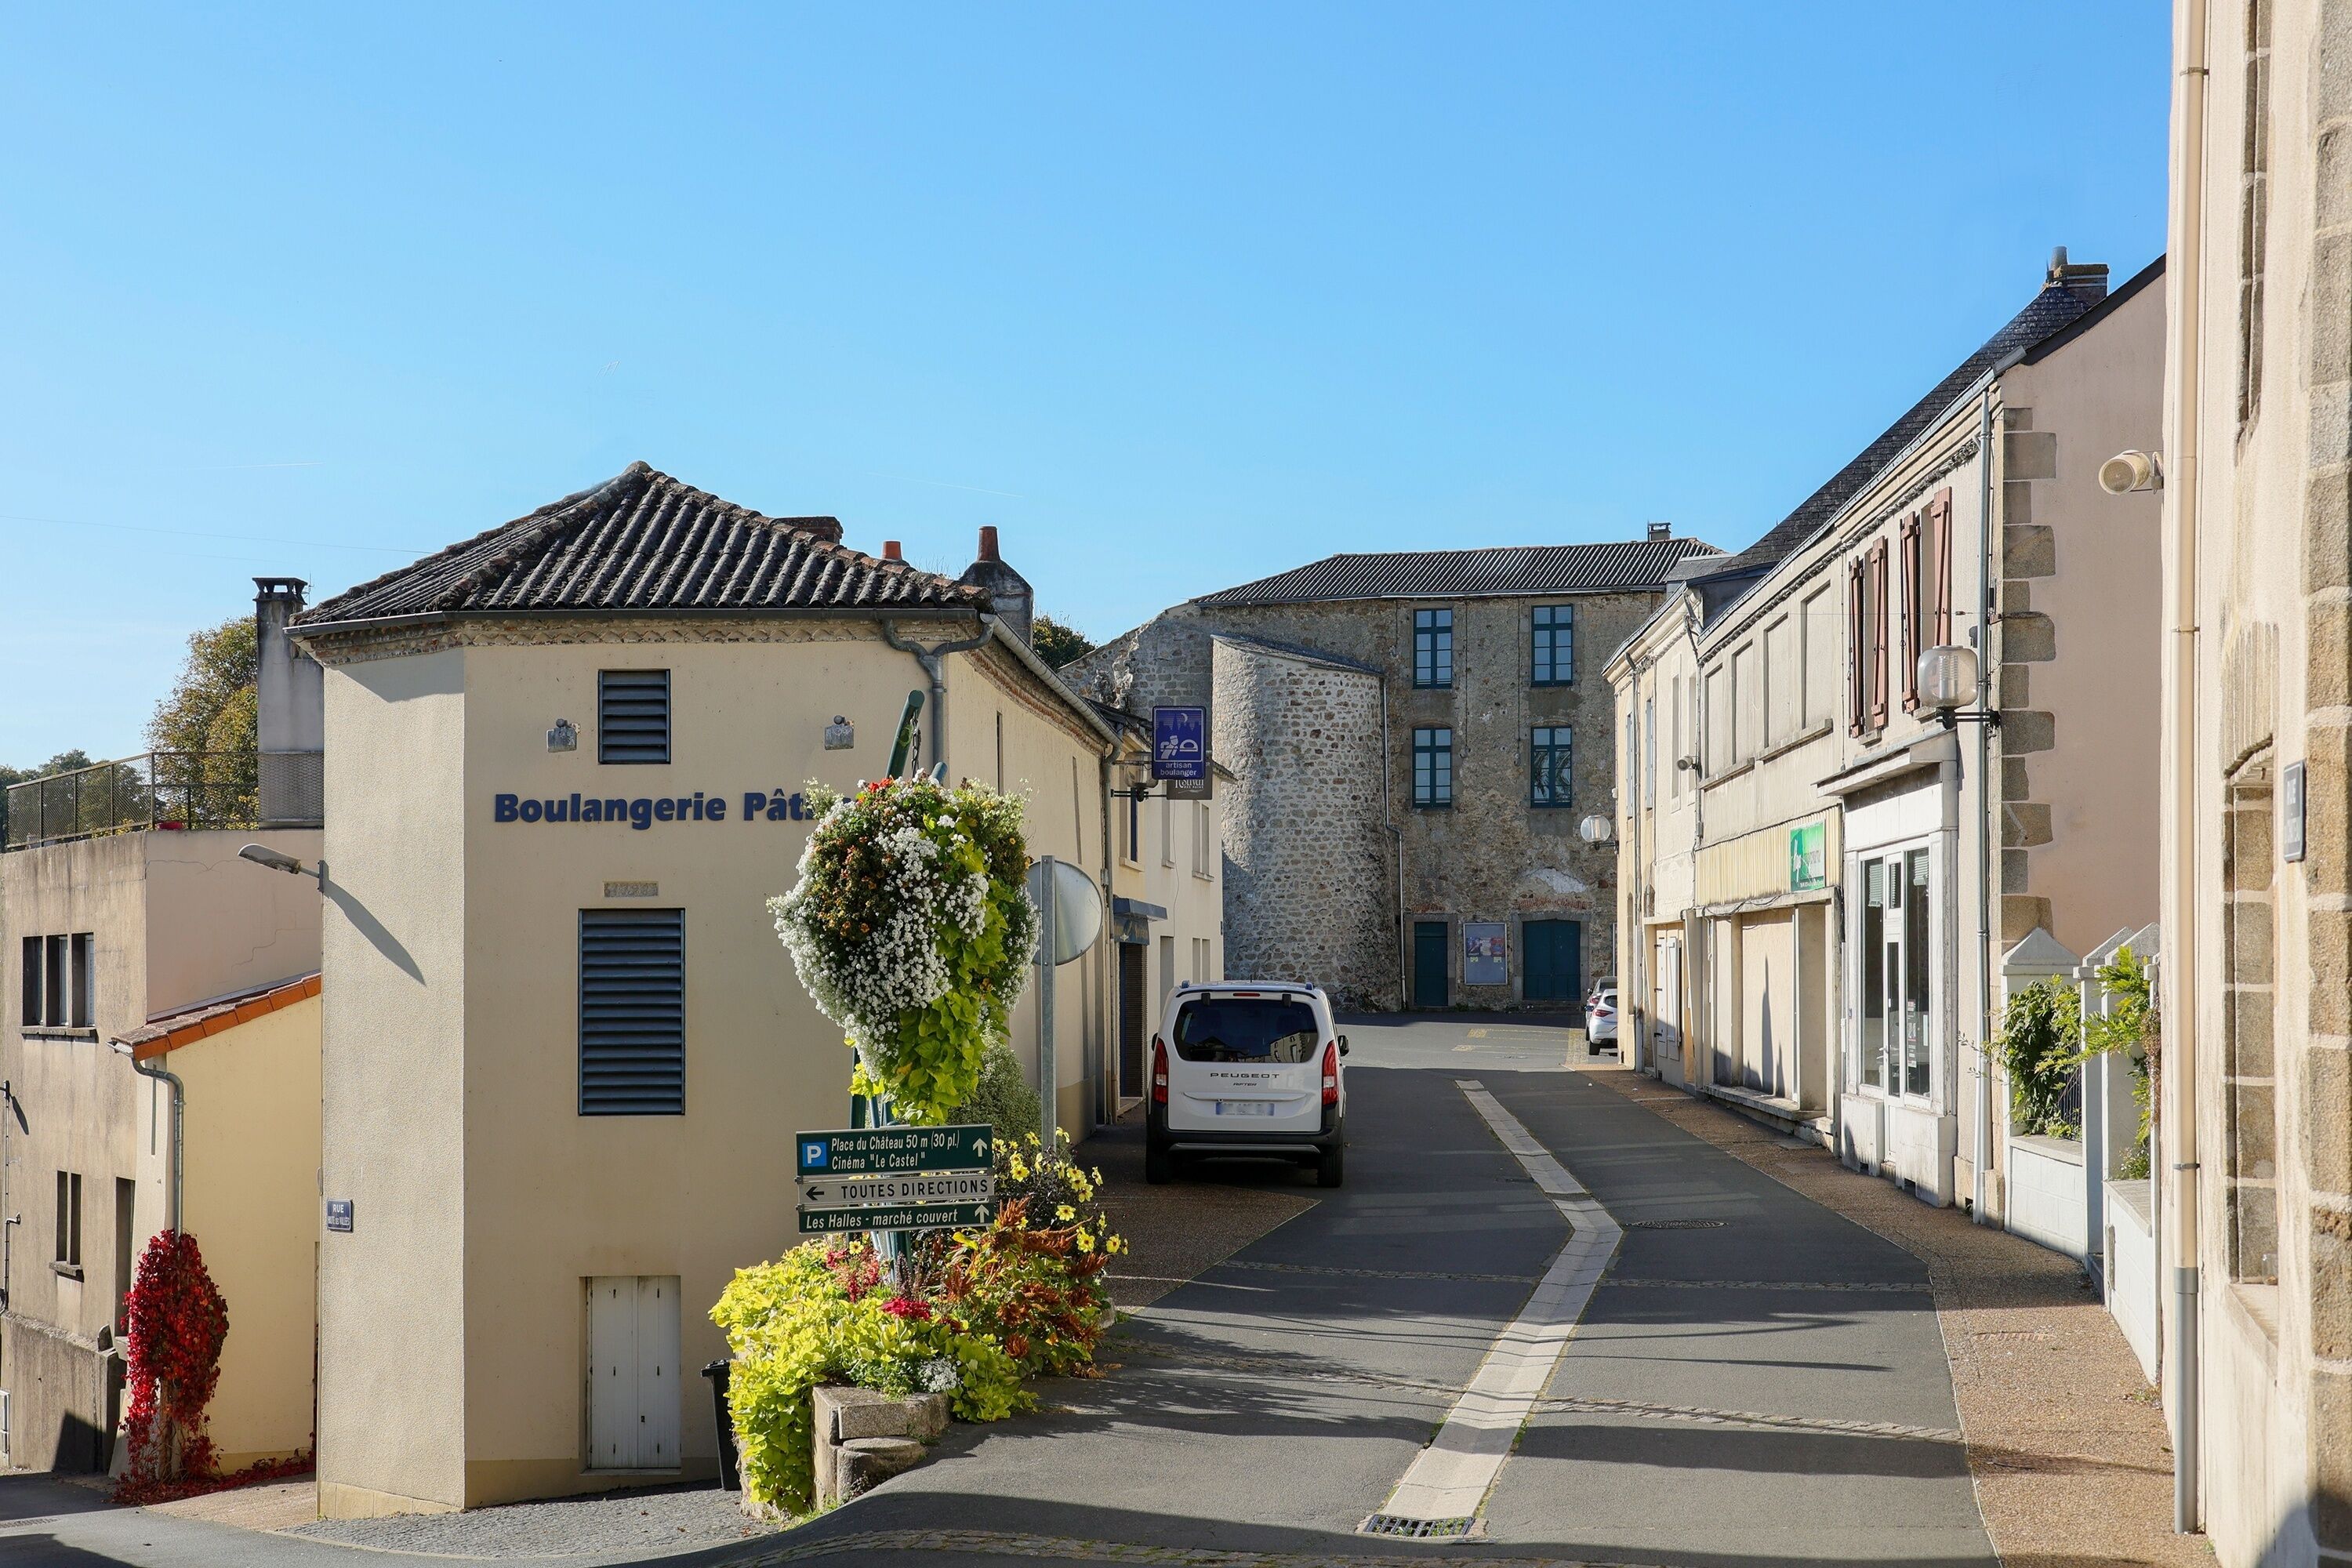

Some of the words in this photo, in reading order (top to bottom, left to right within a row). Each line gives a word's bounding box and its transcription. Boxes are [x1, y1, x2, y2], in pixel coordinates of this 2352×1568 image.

[1160, 769, 1197, 778] boulanger
[495, 791, 727, 831] Boulangerie
[831, 1138, 854, 1152] Place
[856, 1137, 867, 1151] du
[869, 1135, 903, 1150] Château
[906, 1134, 918, 1149] 50
[920, 1137, 928, 1148] m
[931, 1131, 946, 1149] (30
[947, 1129, 960, 1150] pl.)
[832, 1156, 866, 1170] Cinéma
[840, 1183, 895, 1200] TOUTES
[902, 1178, 989, 1196] DIRECTIONS
[332, 1203, 344, 1213] RUE
[806, 1215, 824, 1229] Les
[828, 1214, 862, 1229] Halles
[872, 1210, 912, 1225] marché
[916, 1208, 958, 1224] couvert
